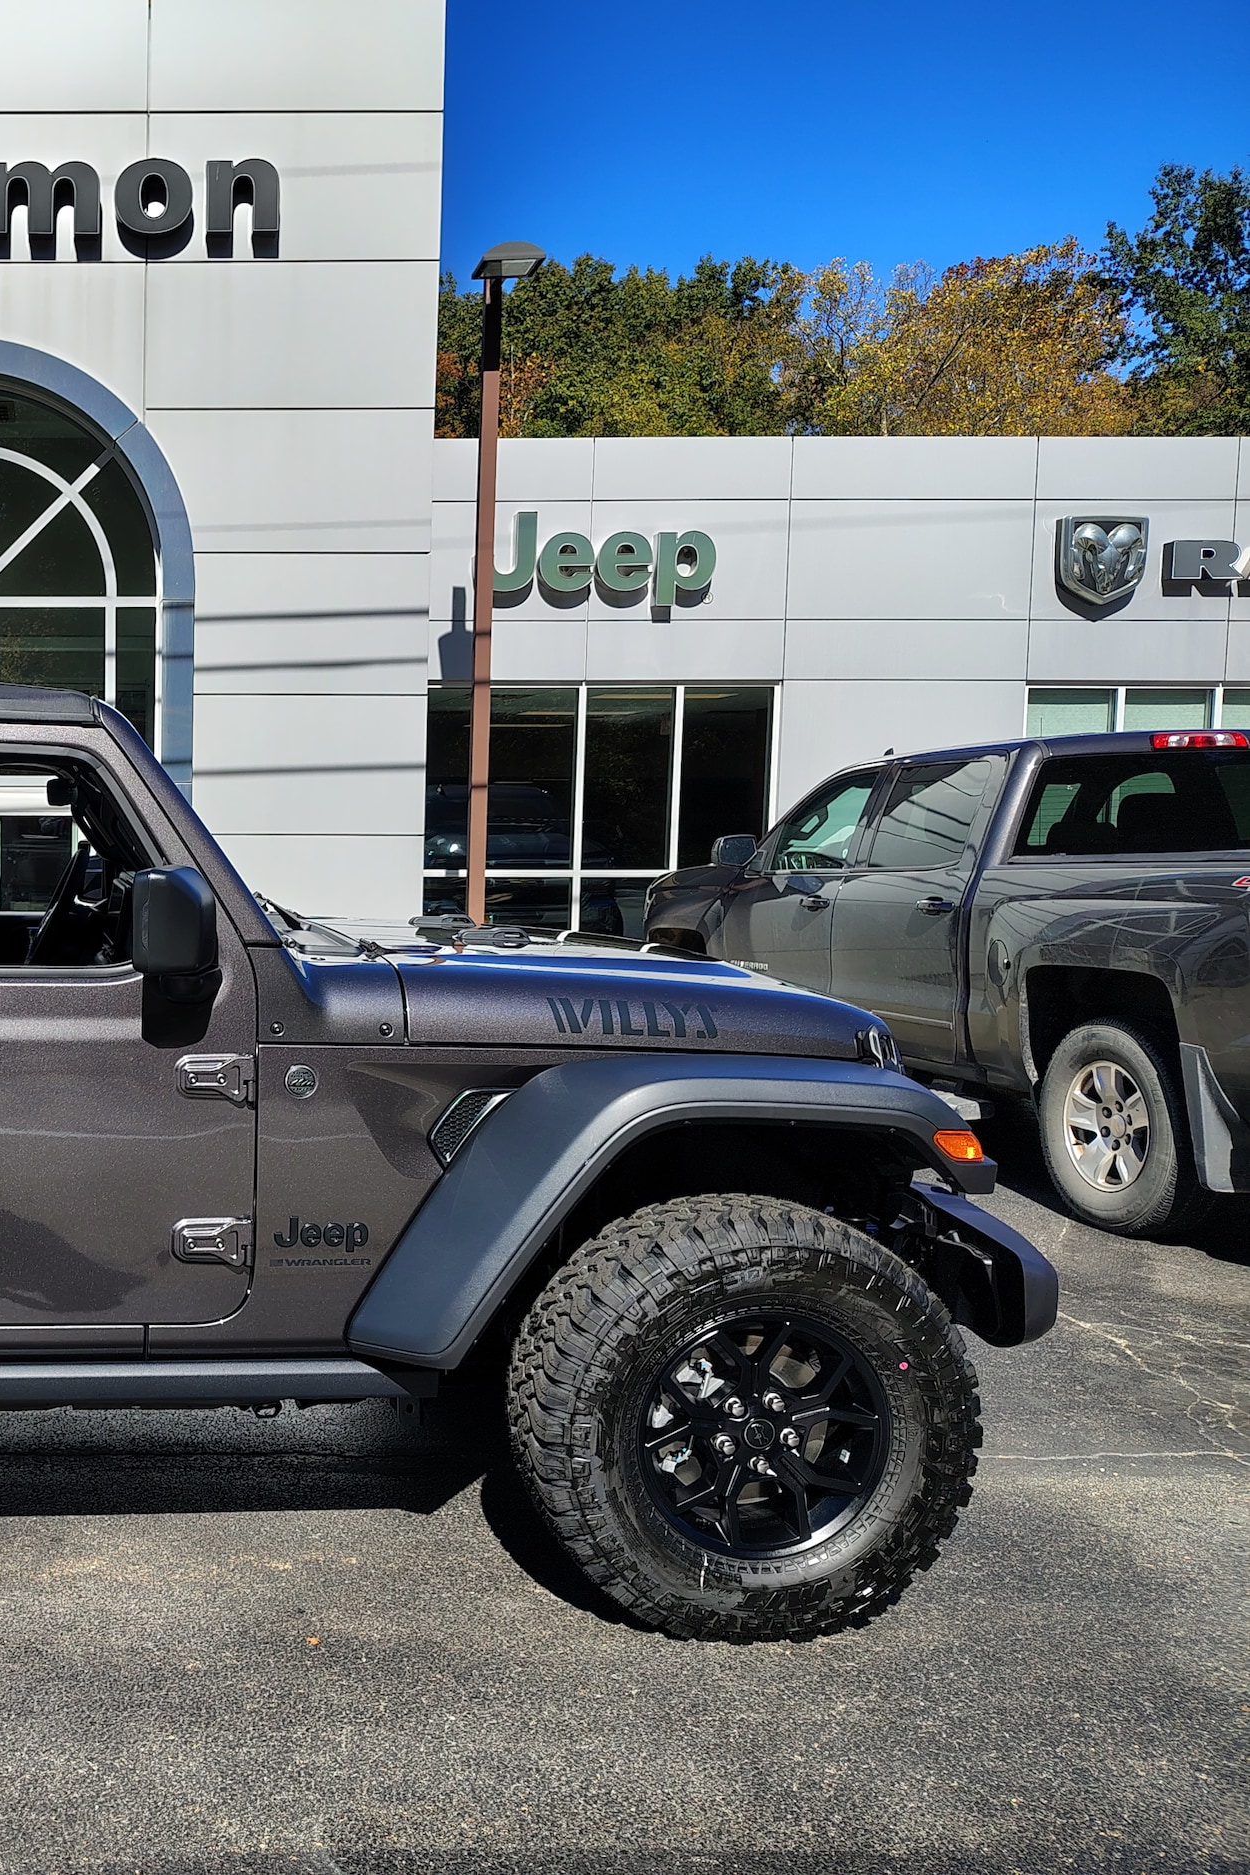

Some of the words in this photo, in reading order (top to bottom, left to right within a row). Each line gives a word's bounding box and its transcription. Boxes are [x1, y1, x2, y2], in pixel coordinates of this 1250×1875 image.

[493, 511, 717, 607] Jeep
[546, 997, 719, 1038] WILLYS
[274, 1216, 369, 1252] Jeep
[285, 1258, 371, 1266] WRANGLER
